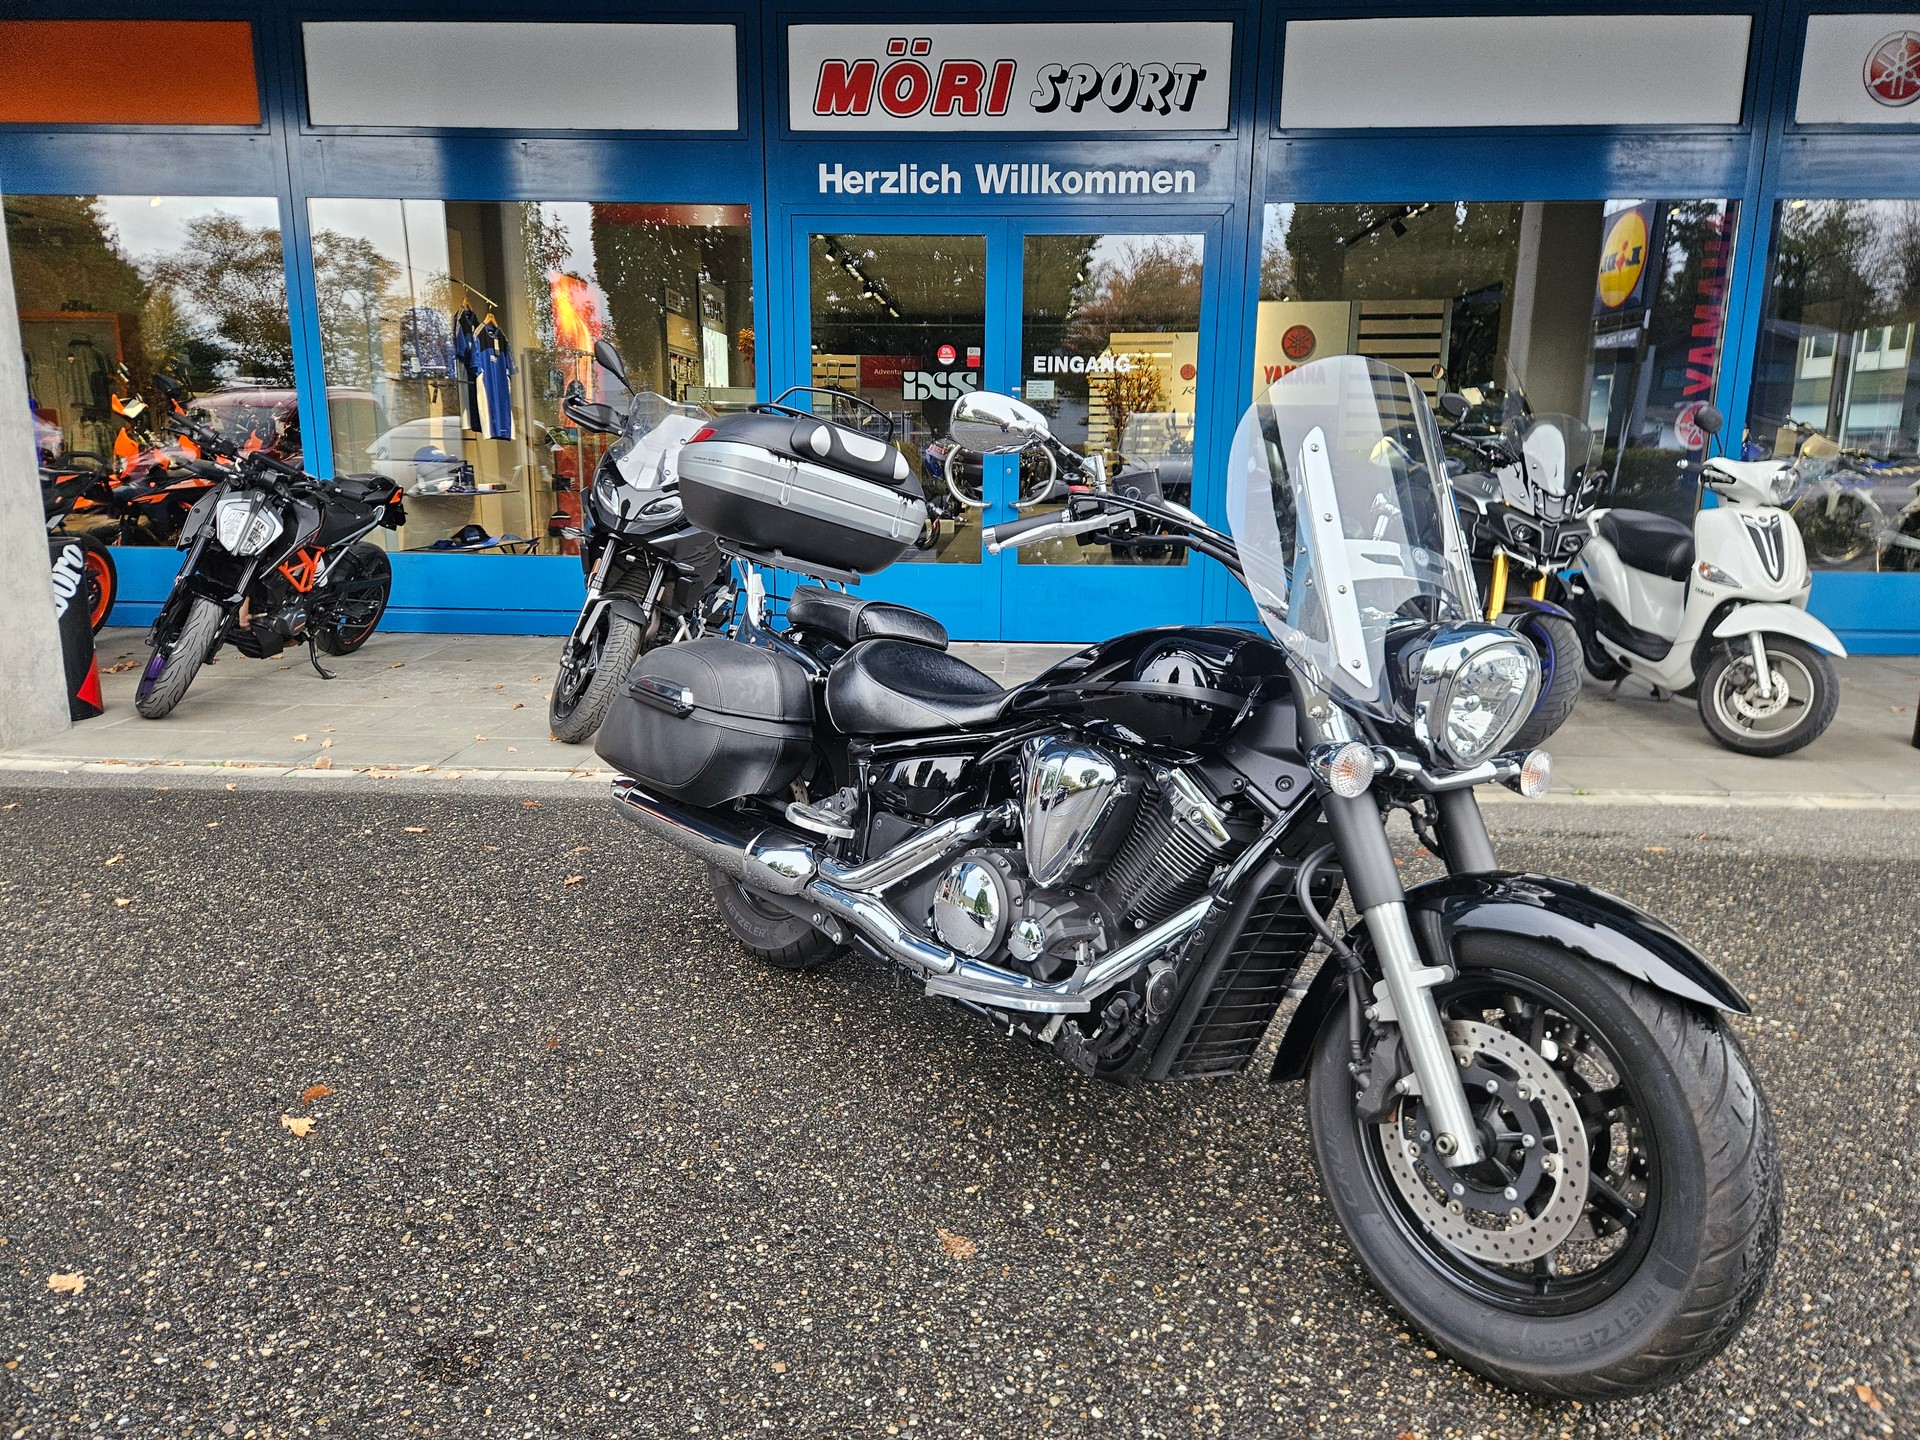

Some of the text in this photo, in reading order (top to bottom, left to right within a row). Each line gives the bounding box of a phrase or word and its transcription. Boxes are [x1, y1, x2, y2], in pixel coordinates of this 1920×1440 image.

[813, 38, 1207, 118] MÖRI SPORT
[818, 163, 1196, 194] Herzlich Willkommen
[873, 368, 902, 376] Adventu
[1033, 355, 1131, 373] EINGANG
[723, 896, 767, 938] METZELER
